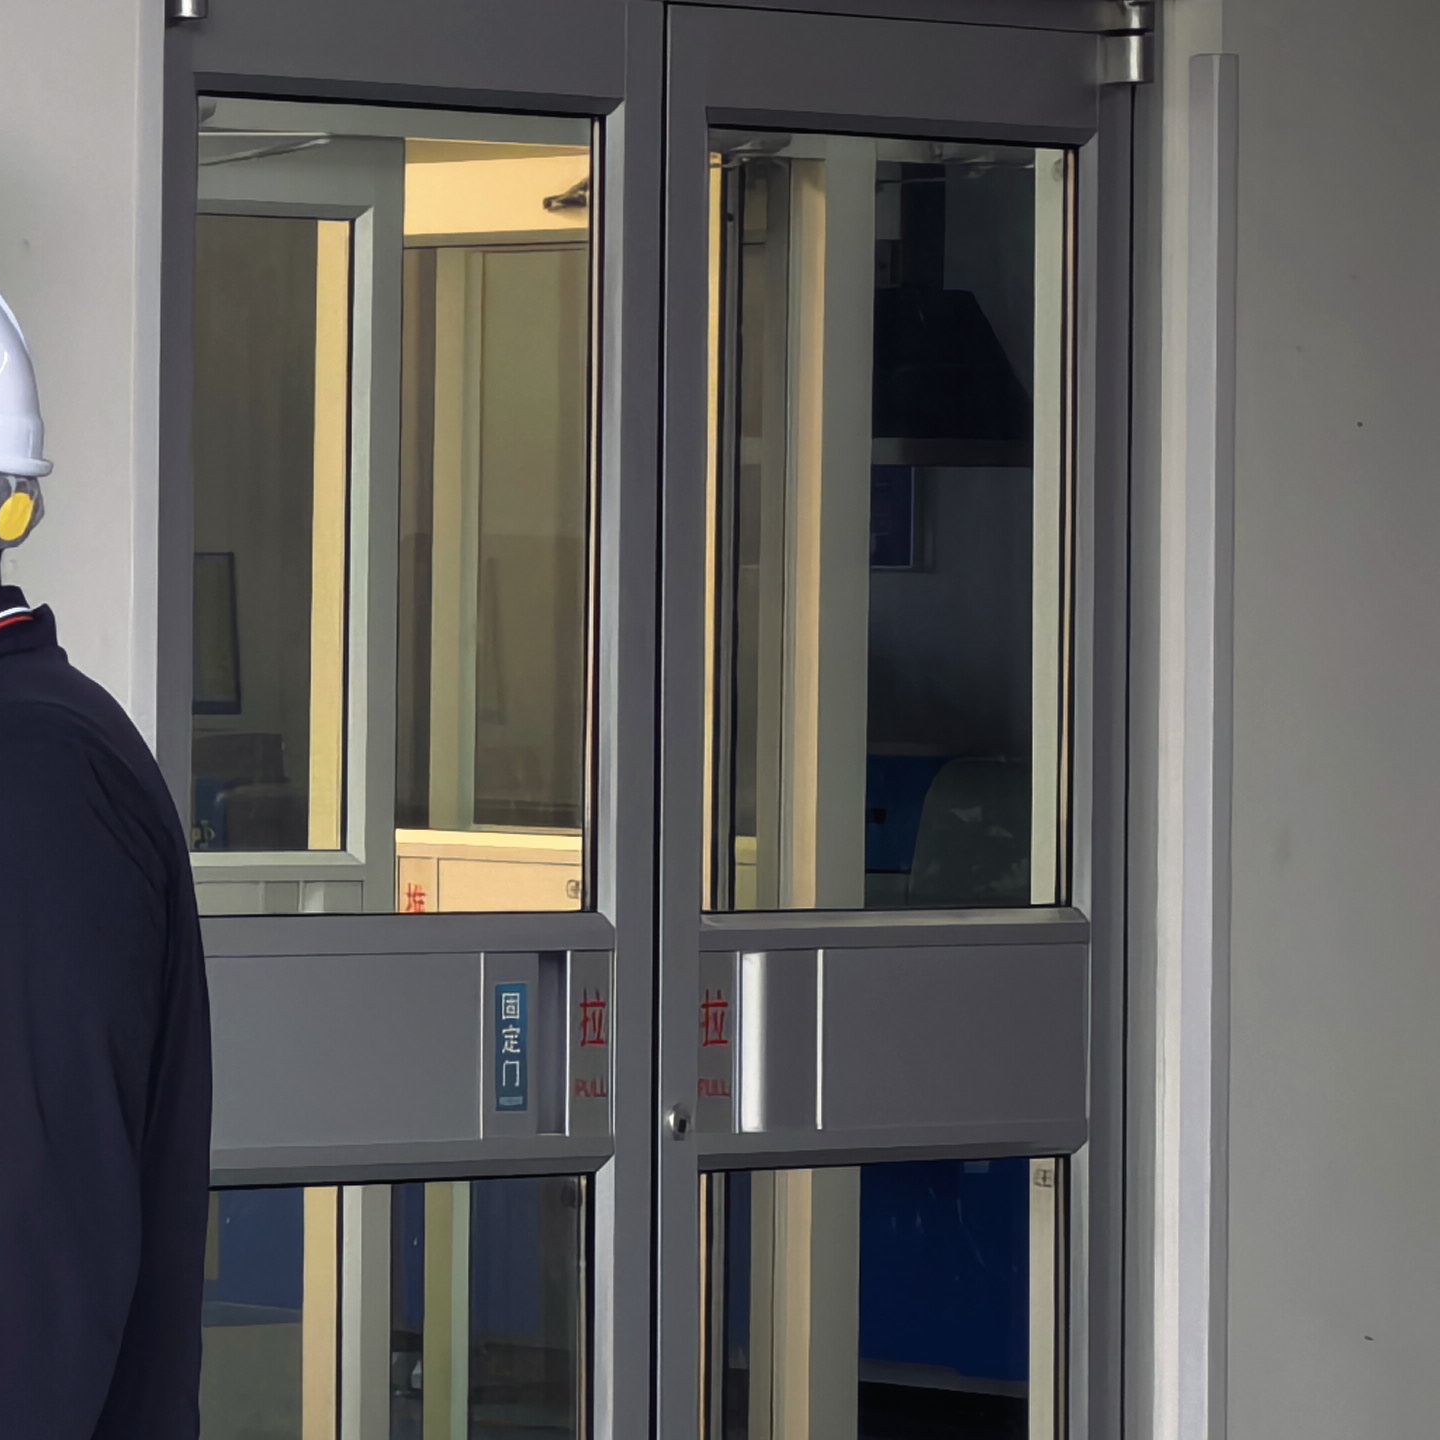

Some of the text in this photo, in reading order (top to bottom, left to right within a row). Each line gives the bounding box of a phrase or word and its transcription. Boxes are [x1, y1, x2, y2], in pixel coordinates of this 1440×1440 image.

[502, 991, 521, 1087] 固定门
[580, 988, 608, 1048] 拉
[701, 988, 729, 1048] 拉
[575, 1077, 608, 1098] PULL
[698, 1077, 731, 1098] PULL
